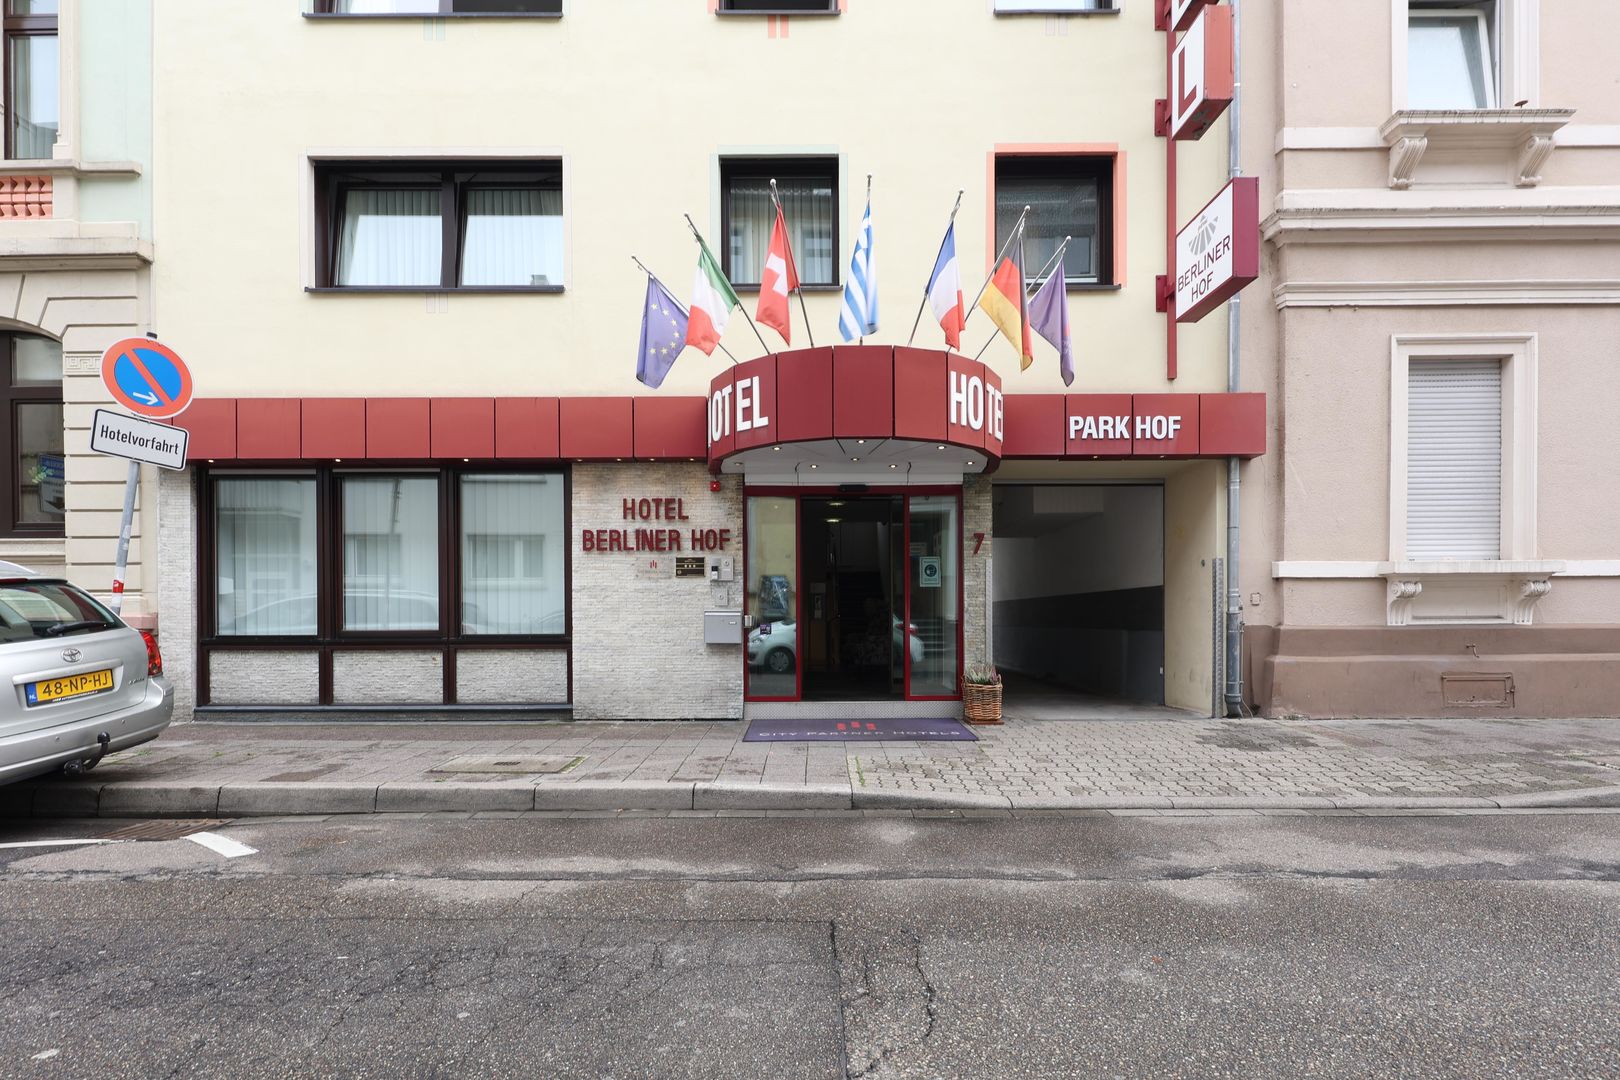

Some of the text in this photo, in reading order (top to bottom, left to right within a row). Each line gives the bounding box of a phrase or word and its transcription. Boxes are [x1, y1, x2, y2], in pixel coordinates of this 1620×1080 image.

[1178, 235, 1231, 293] BERLINER
[1191, 271, 1214, 302] HOF
[708, 375, 769, 448] OTEL
[950, 370, 1004, 443] HOTE
[100, 424, 179, 455] Hotelvorfahrt
[1069, 415, 1182, 439] PARK HOF
[622, 498, 689, 520] HOTEL
[582, 529, 731, 551] BERLINER HOF
[973, 532, 985, 555] 7
[42, 673, 108, 696] 48-NP-HJ
